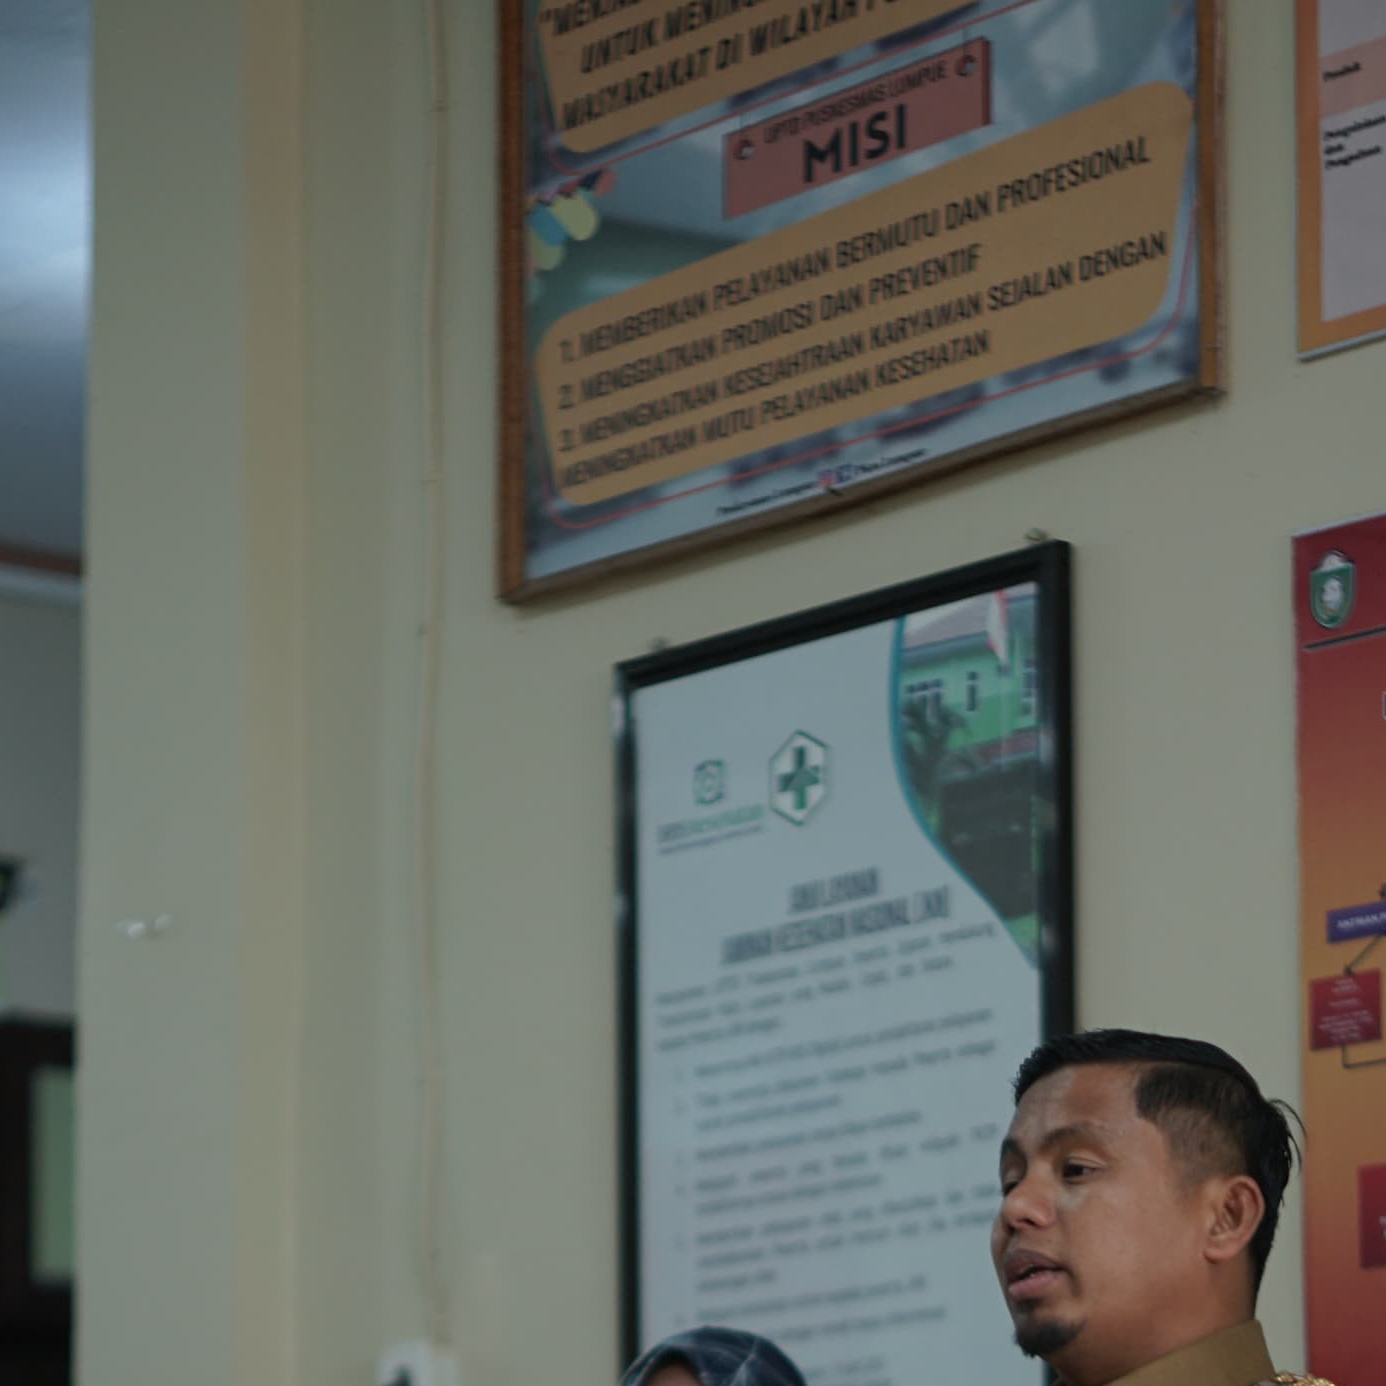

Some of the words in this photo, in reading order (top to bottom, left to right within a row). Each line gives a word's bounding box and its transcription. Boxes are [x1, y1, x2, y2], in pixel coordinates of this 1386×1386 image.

[580, 17, 660, 73] UNTUK
[716, 33, 743, 70] DI
[804, 103, 906, 183] MISI
[580, 287, 709, 356] MEMBERIKAN
[712, 248, 830, 311] PELAYANAN
[835, 208, 941, 268] BERMUTU
[945, 190, 993, 231] DAN
[996, 137, 1152, 212] PROFESIONAL
[720, 301, 814, 353] PROMOSI
[819, 283, 864, 321] DAN
[868, 243, 982, 304] PREVENTIF
[869, 290, 983, 349] KARYAWAN
[986, 260, 1074, 311] SEJALAN
[1078, 231, 1167, 281] DENGAN
[701, 405, 757, 442] MUTU
[760, 367, 870, 425] PELAYANAN
[874, 328, 992, 387] KESEHATAN
